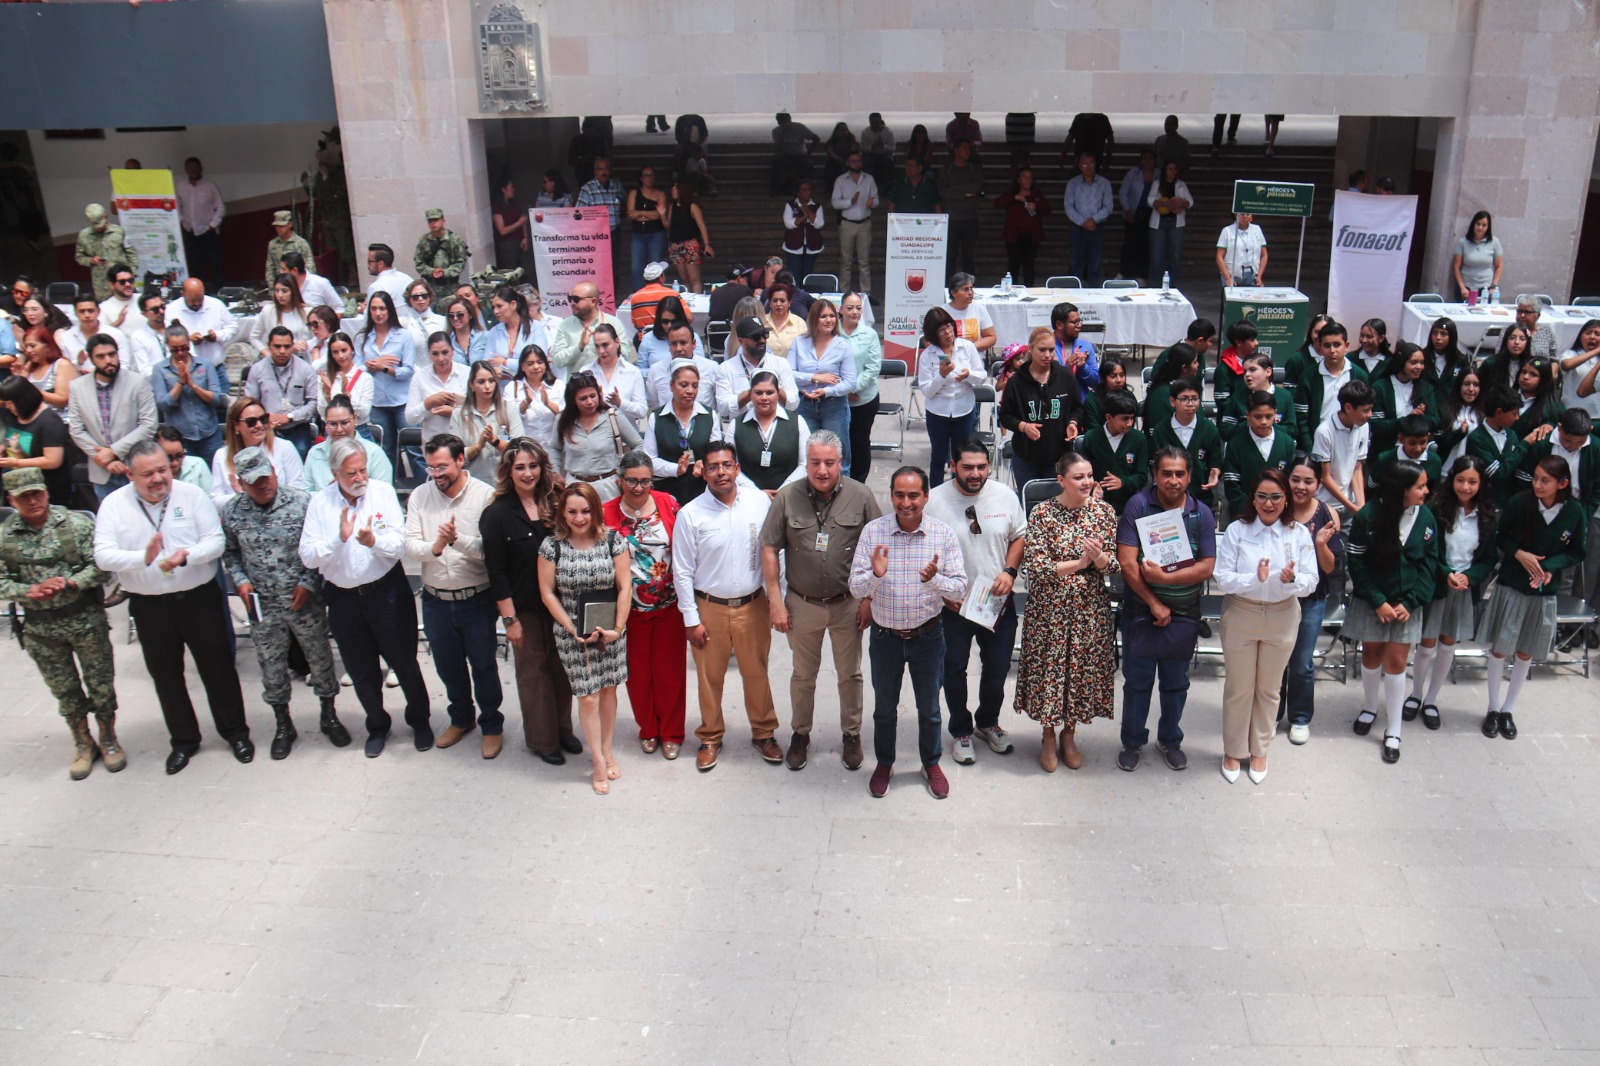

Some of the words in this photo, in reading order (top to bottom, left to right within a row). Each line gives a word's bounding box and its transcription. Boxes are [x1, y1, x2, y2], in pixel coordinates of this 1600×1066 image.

[533, 233, 579, 242] Transforma
[591, 232, 609, 240] vida
[1336, 225, 1408, 251] fonacot
[548, 245, 596, 253] terminando
[552, 257, 586, 266] primaria
[551, 268, 596, 276] secundaria
[1256, 313, 1295, 321] paisanos
[1028, 398, 1061, 422] JB
